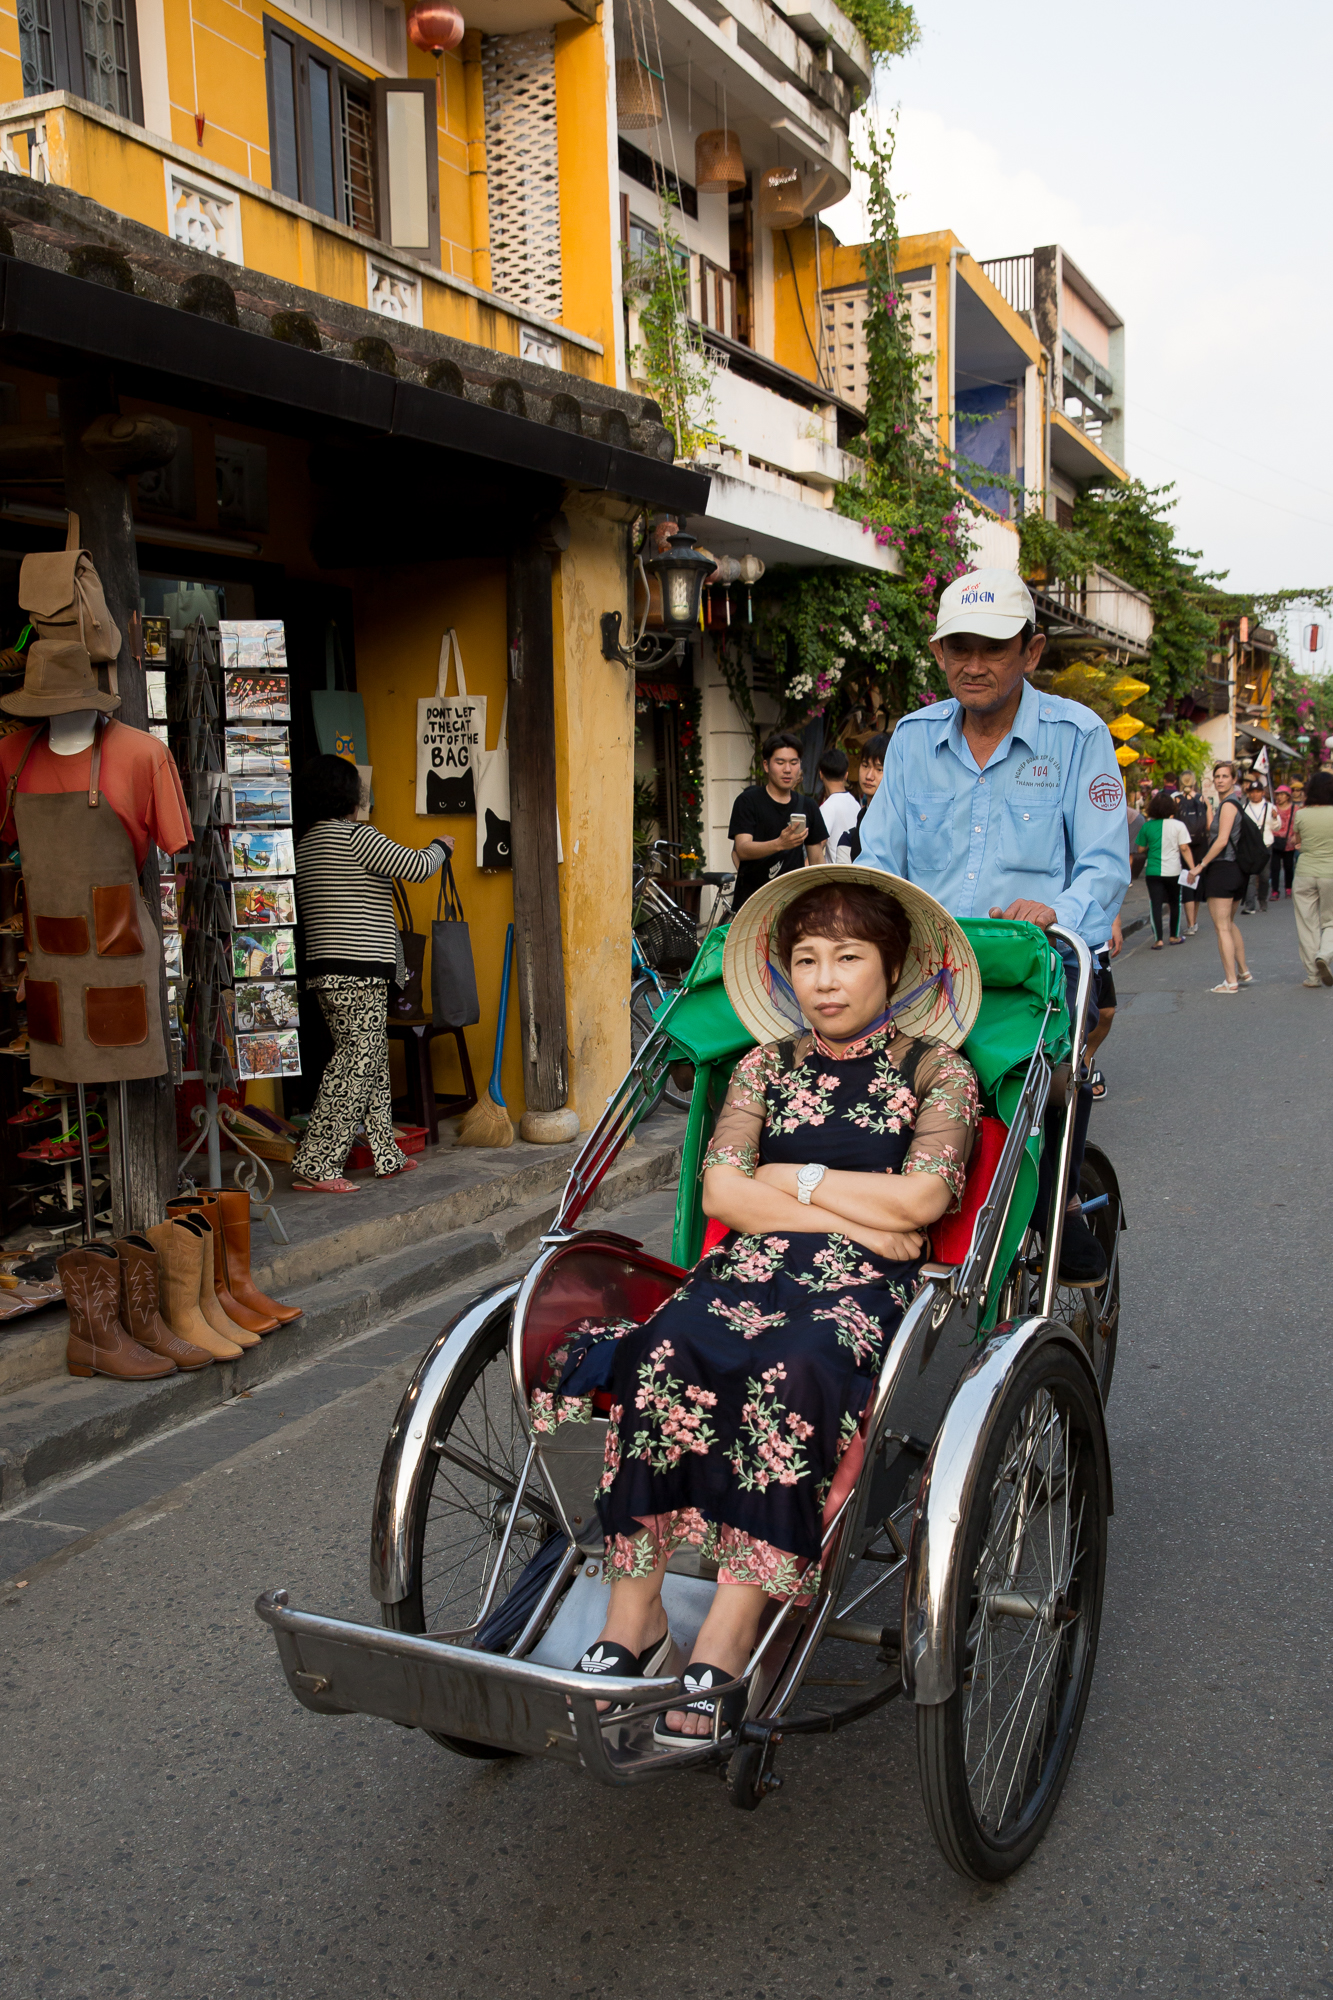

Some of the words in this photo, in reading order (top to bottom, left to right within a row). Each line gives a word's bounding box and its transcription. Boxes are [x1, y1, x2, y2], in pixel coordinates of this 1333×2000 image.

[979, 591, 995, 603] AN
[427, 707, 452, 720] DONT
[455, 706, 476, 718] LET
[428, 721, 452, 733] THE
[452, 719, 471, 732] CAT
[423, 734, 445, 745] OUT
[446, 734, 459, 746] OF
[460, 732, 479, 745] THE
[431, 746, 469, 768] BAG
[1032, 765, 1048, 777] 104
[687, 1700, 715, 1712] ida
